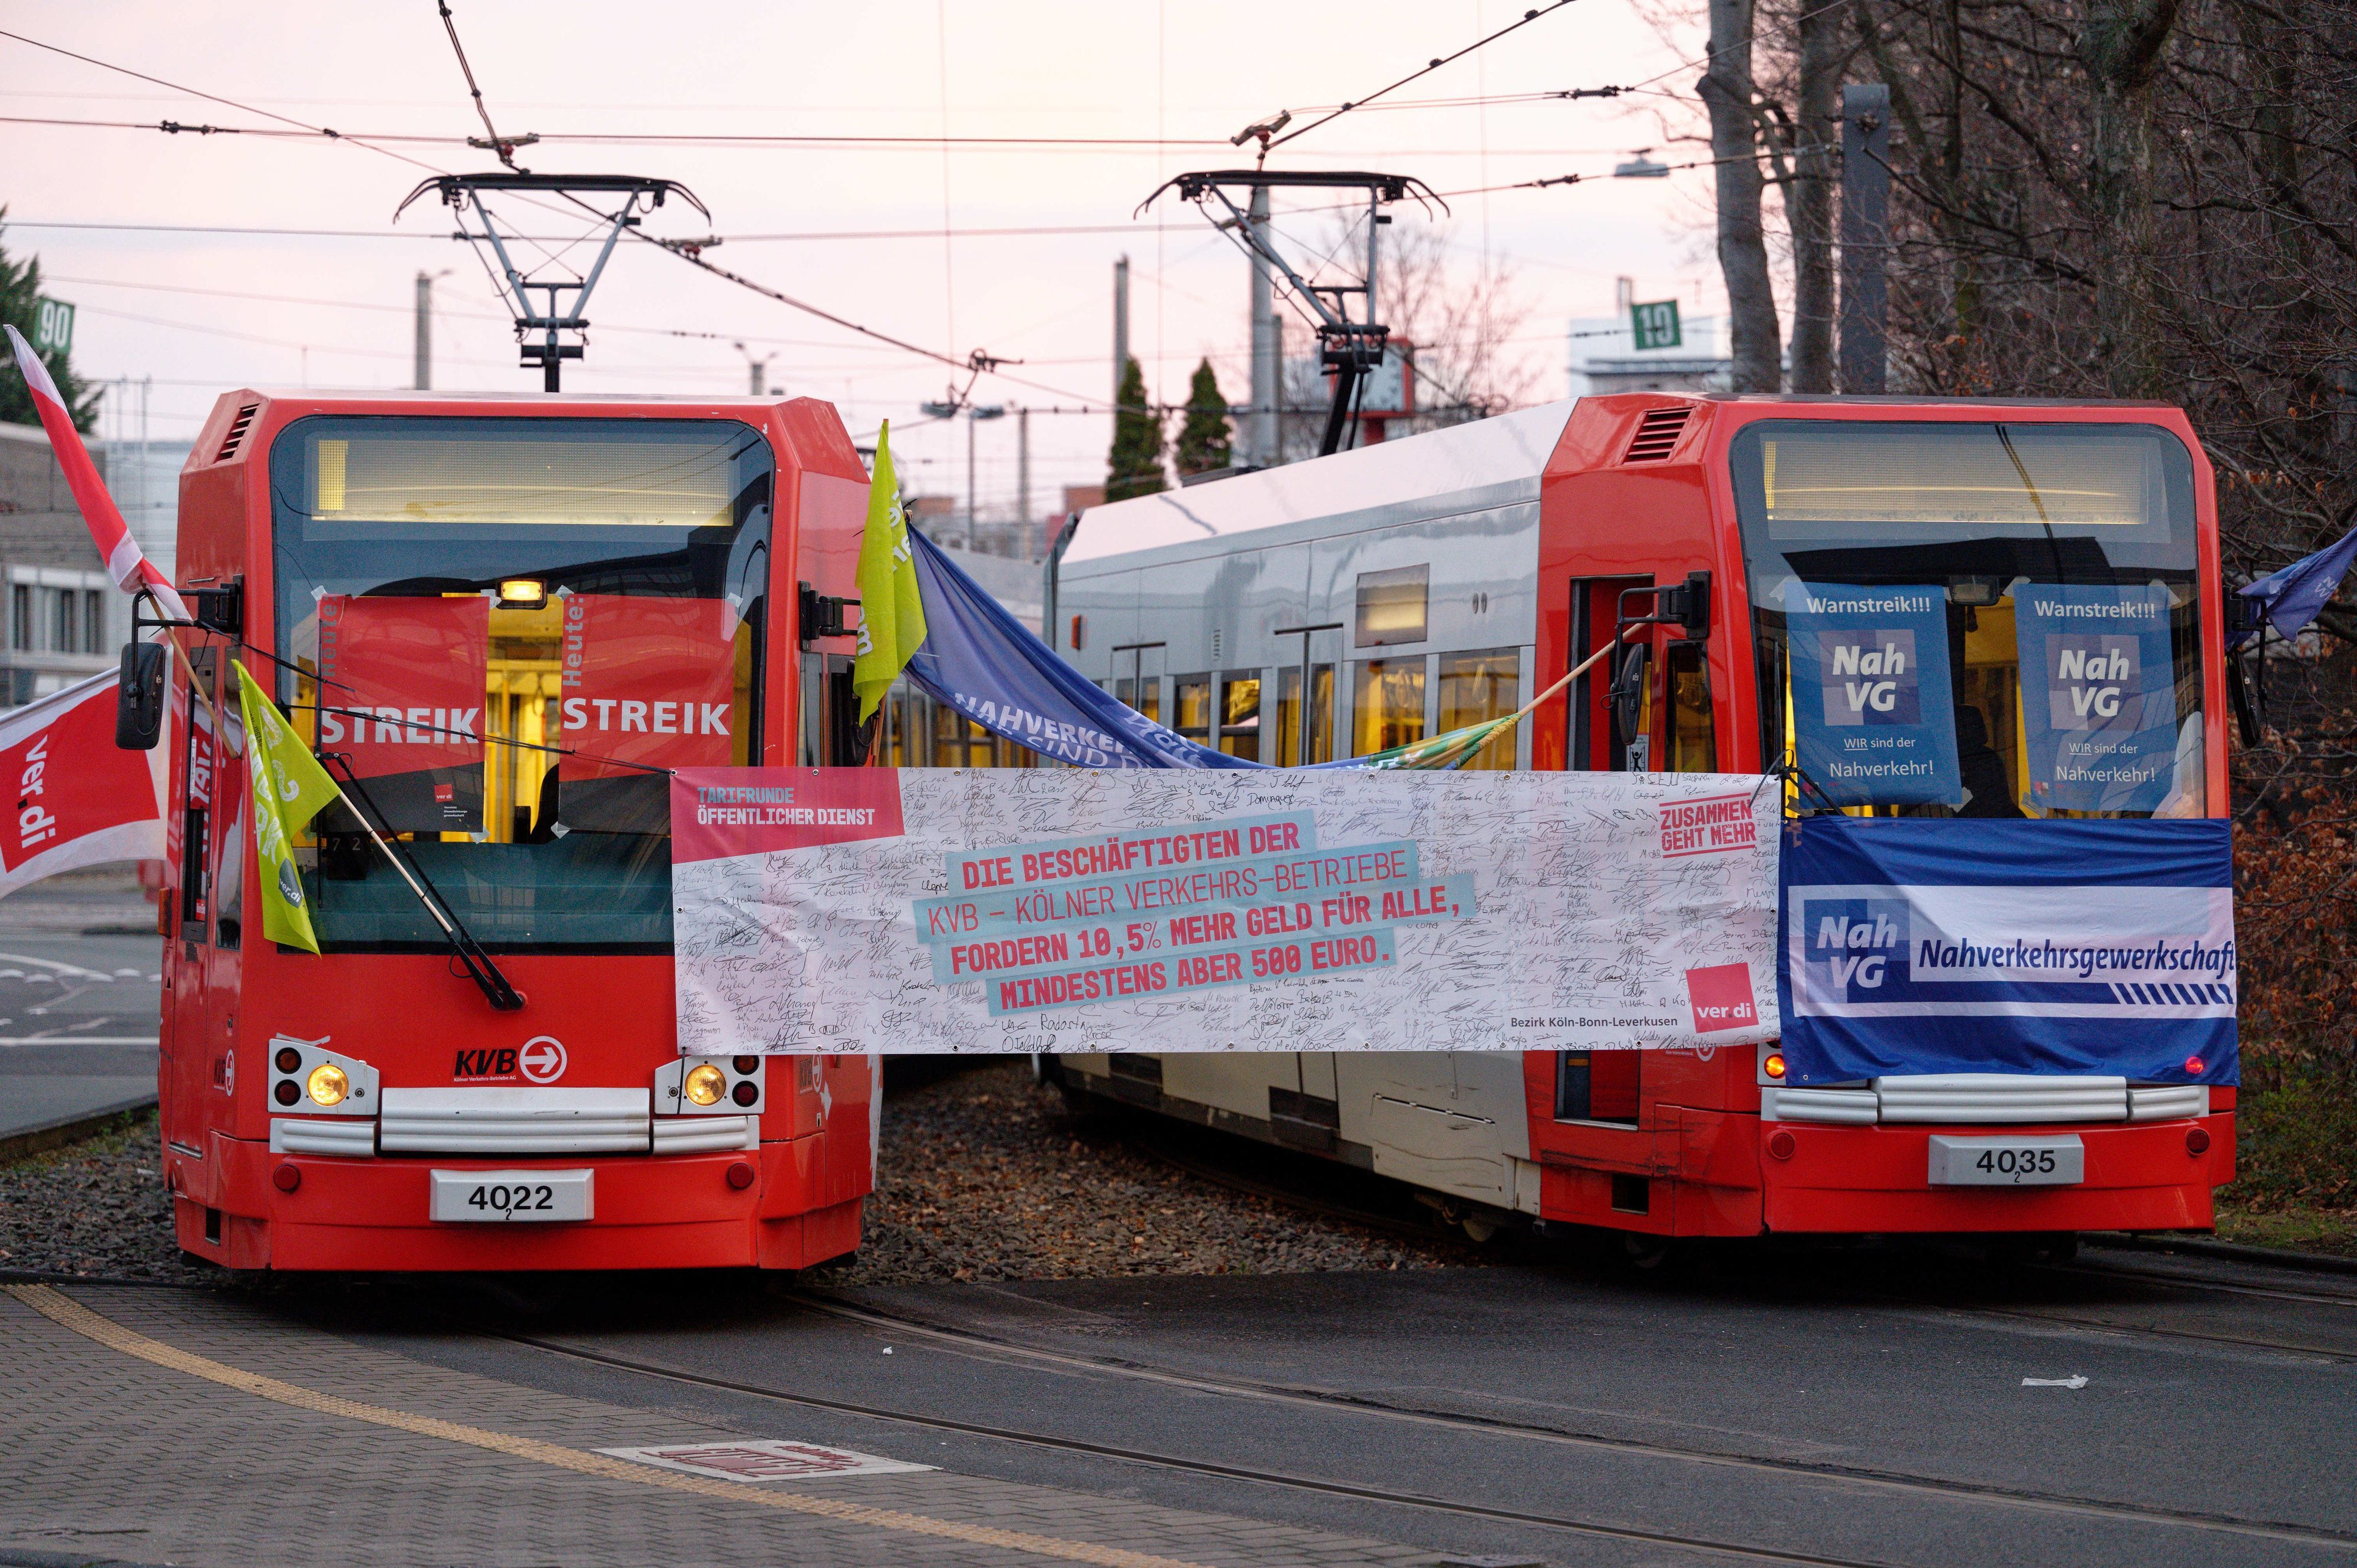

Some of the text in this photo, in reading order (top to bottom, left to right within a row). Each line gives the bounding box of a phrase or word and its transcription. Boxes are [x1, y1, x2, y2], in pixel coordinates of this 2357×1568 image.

[40, 302, 70, 348] 90
[1806, 596, 1931, 613] Warnstreik!!!
[2035, 600, 2155, 619] Warnstreik!!!
[322, 596, 338, 677] Heute:
[563, 598, 583, 686] Heute:
[1832, 643, 1906, 675] Nah
[2058, 648, 2130, 681] Nah
[1845, 682, 1896, 712] VG
[2071, 686, 2121, 717] VG
[322, 707, 480, 744] STREIK
[564, 698, 730, 735] STREIK
[1844, 737, 1916, 750] WIR sind der
[2069, 742, 2138, 755] WIR sind der
[1830, 760, 1933, 777] Nahverkehr!
[2056, 765, 2155, 782] Nahverkehr!
[18, 734, 55, 849] ver.di
[698, 787, 794, 803] TARIFRUNDE
[698, 805, 875, 825] ÖFFENTLICHER DIENST
[1659, 799, 1753, 830] ZUSAMMEN
[1661, 822, 1757, 851] GEHT MEHR
[962, 857, 1014, 890] DIE
[1022, 833, 1240, 883] BESCHÄFTIGTEN
[1250, 822, 1300, 854] DER
[928, 903, 979, 937] KVB
[1016, 889, 1115, 925] KÖLNER
[1125, 849, 1408, 910] VERKEHRS-BETRIEBE
[951, 886, 1460, 975] FORDERN 10,5% MEHR GELD FÜR ALLE,
[1817, 914, 1898, 949] Nah
[1001, 935, 1389, 1010] MINDESTENS ABER 500 EURO.
[1830, 956, 1886, 988] VG
[1919, 938, 2235, 980] Nahverkehrsgewerkschaft
[1511, 1016, 1678, 1028] Bezirk Köln-Bonn-Leverkusen
[1696, 1002, 1751, 1020] ver.di
[454, 1048, 517, 1076] KVB
[1976, 1150, 2056, 1173] 4035
[468, 1186, 553, 1210] 4022
